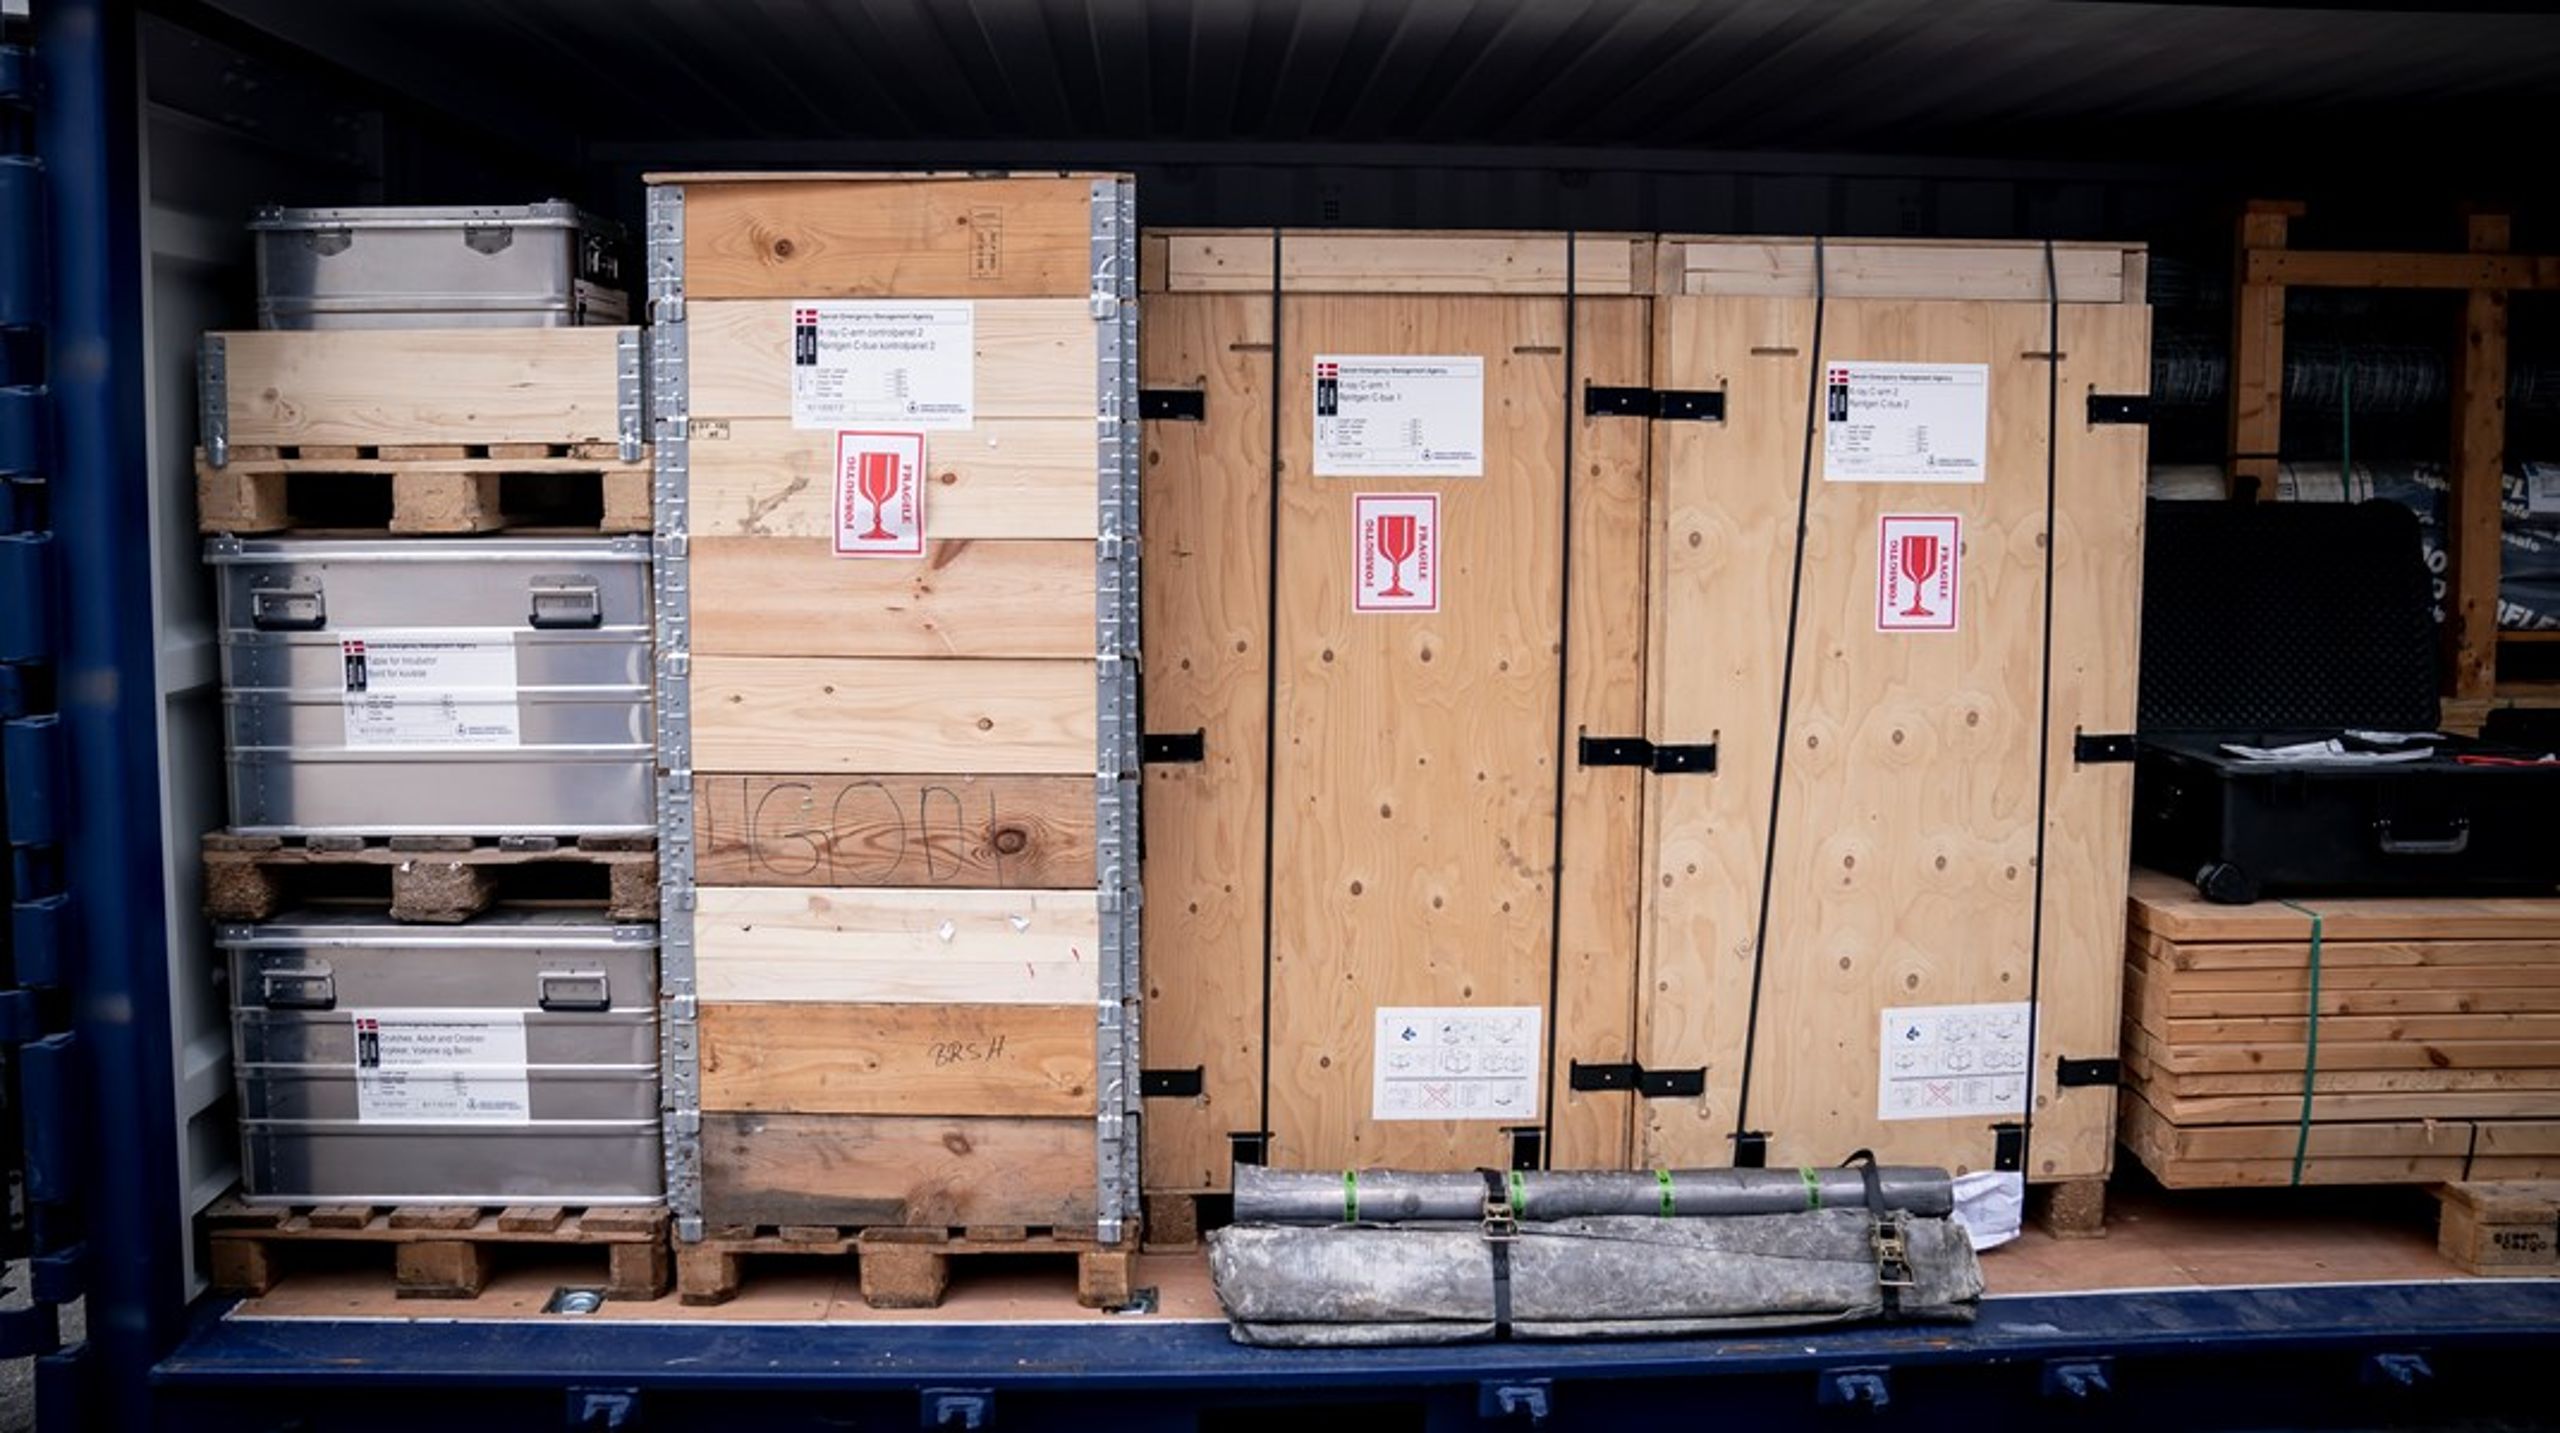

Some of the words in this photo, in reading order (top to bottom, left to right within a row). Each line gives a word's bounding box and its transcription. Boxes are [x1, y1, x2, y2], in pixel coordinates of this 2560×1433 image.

[901, 464, 912, 524] FRAGILE
[1364, 519, 1374, 588] FORSIGTIG
[1418, 526, 1428, 581] FRAGILE
